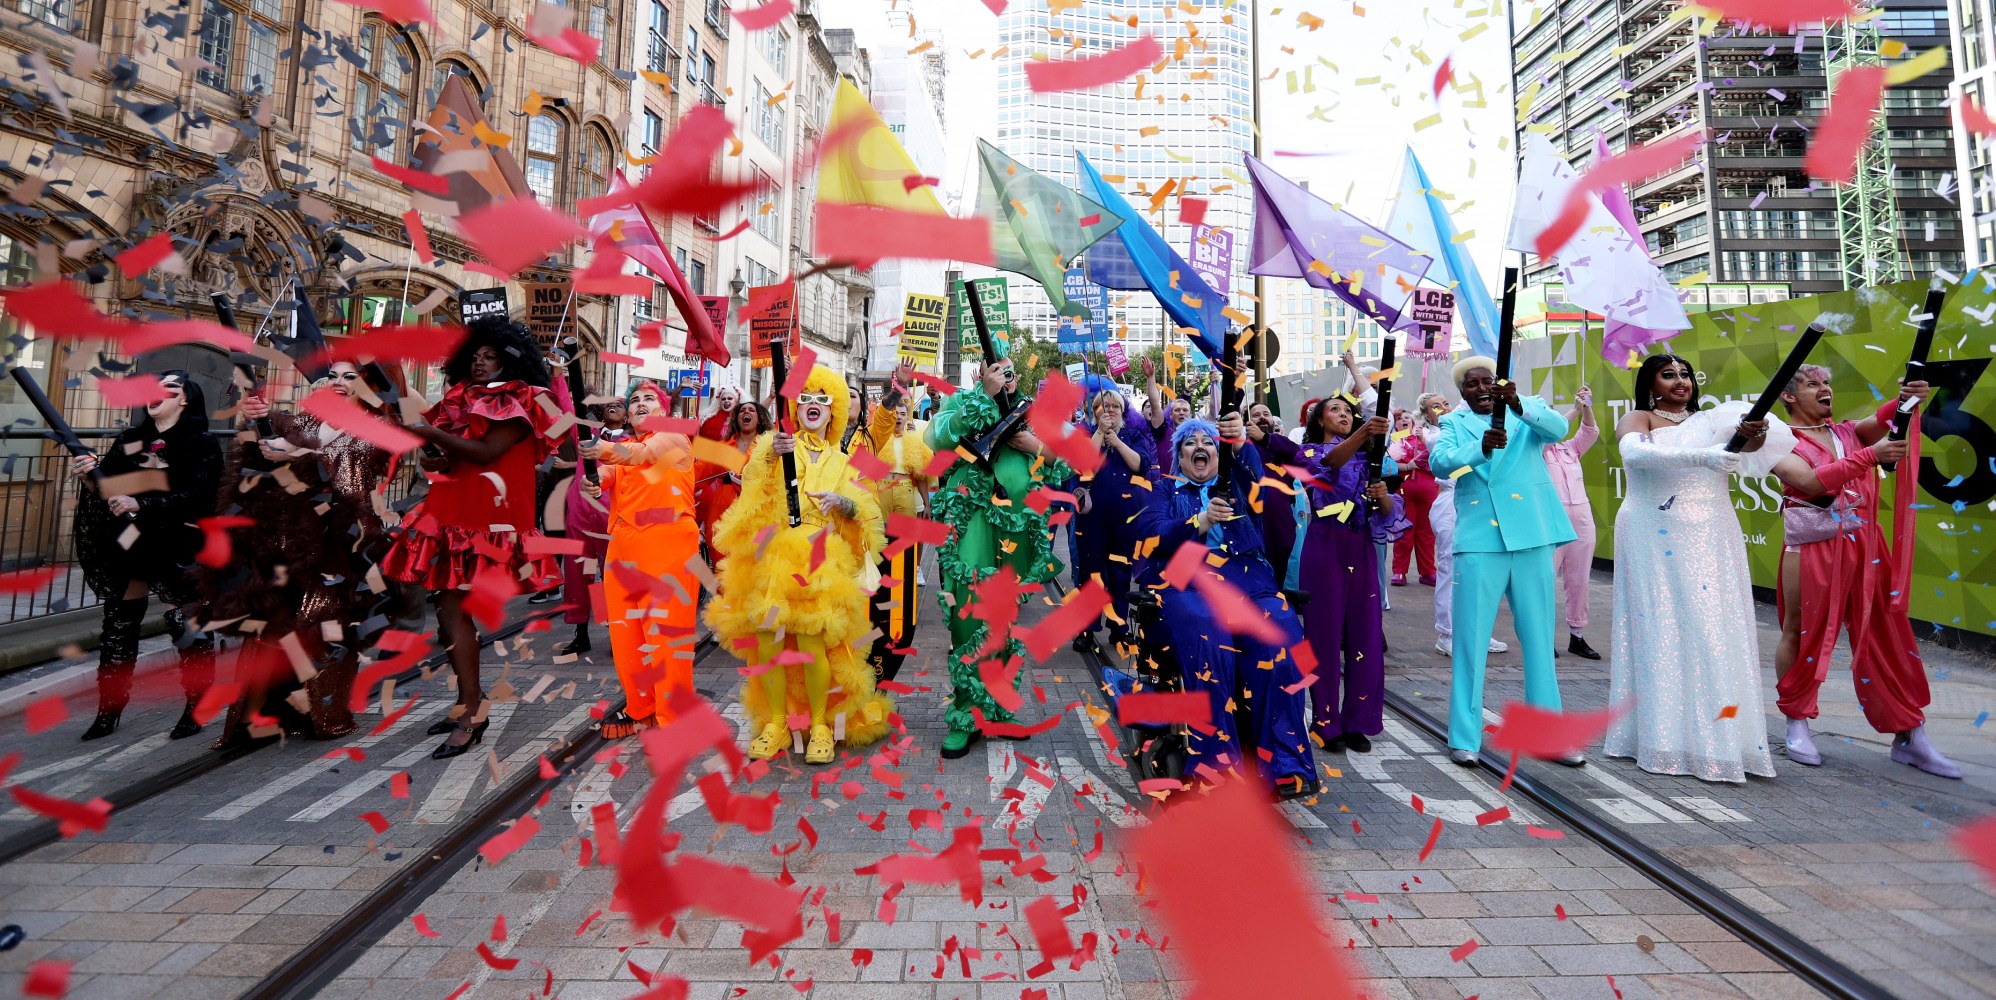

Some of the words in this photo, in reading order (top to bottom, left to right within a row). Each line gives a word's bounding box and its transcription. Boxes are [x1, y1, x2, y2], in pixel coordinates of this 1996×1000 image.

[1202, 228, 1224, 244] END
[1192, 260, 1227, 278] ERASURE
[535, 288, 562, 303] NO
[1414, 290, 1455, 308] LGB
[463, 300, 505, 314] BLACK
[907, 296, 943, 315] LIVE
[963, 312, 1006, 323] FEMES!
[1416, 311, 1434, 320] WITH
[1435, 313, 1448, 321] THE
[530, 324, 574, 334] WITHOUT
[753, 320, 795, 329] MISOGYNY
[904, 321, 941, 331] LAUGH
[1420, 324, 1442, 349] T
[1906, 357, 1996, 506] 3
